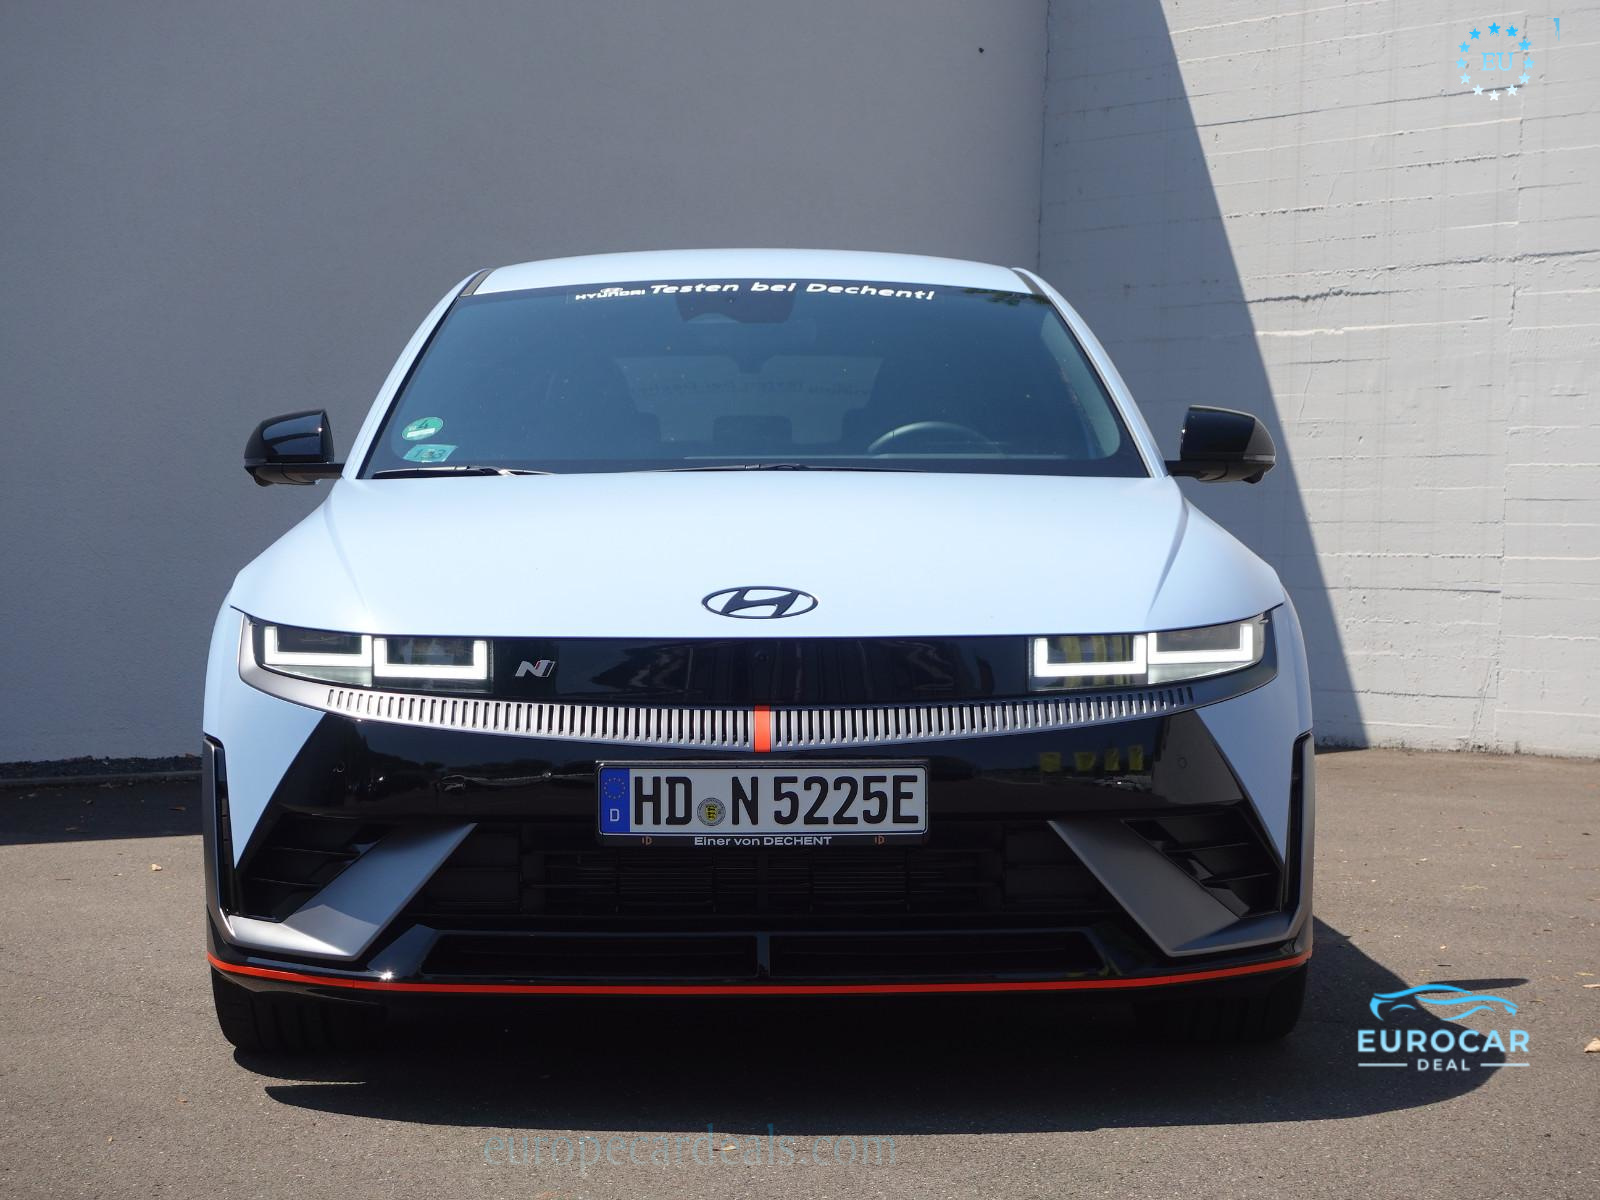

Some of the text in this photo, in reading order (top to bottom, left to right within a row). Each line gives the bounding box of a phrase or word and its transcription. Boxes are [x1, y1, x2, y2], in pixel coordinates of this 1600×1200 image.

[650, 283, 739, 294] Testen
[750, 282, 797, 293] bei
[806, 283, 935, 302] Dechent!
[634, 776, 693, 825] HD
[731, 776, 759, 825] N
[773, 775, 919, 825] 5225E
[609, 808, 620, 822] D
[694, 836, 833, 846] Einer von DECHENT
